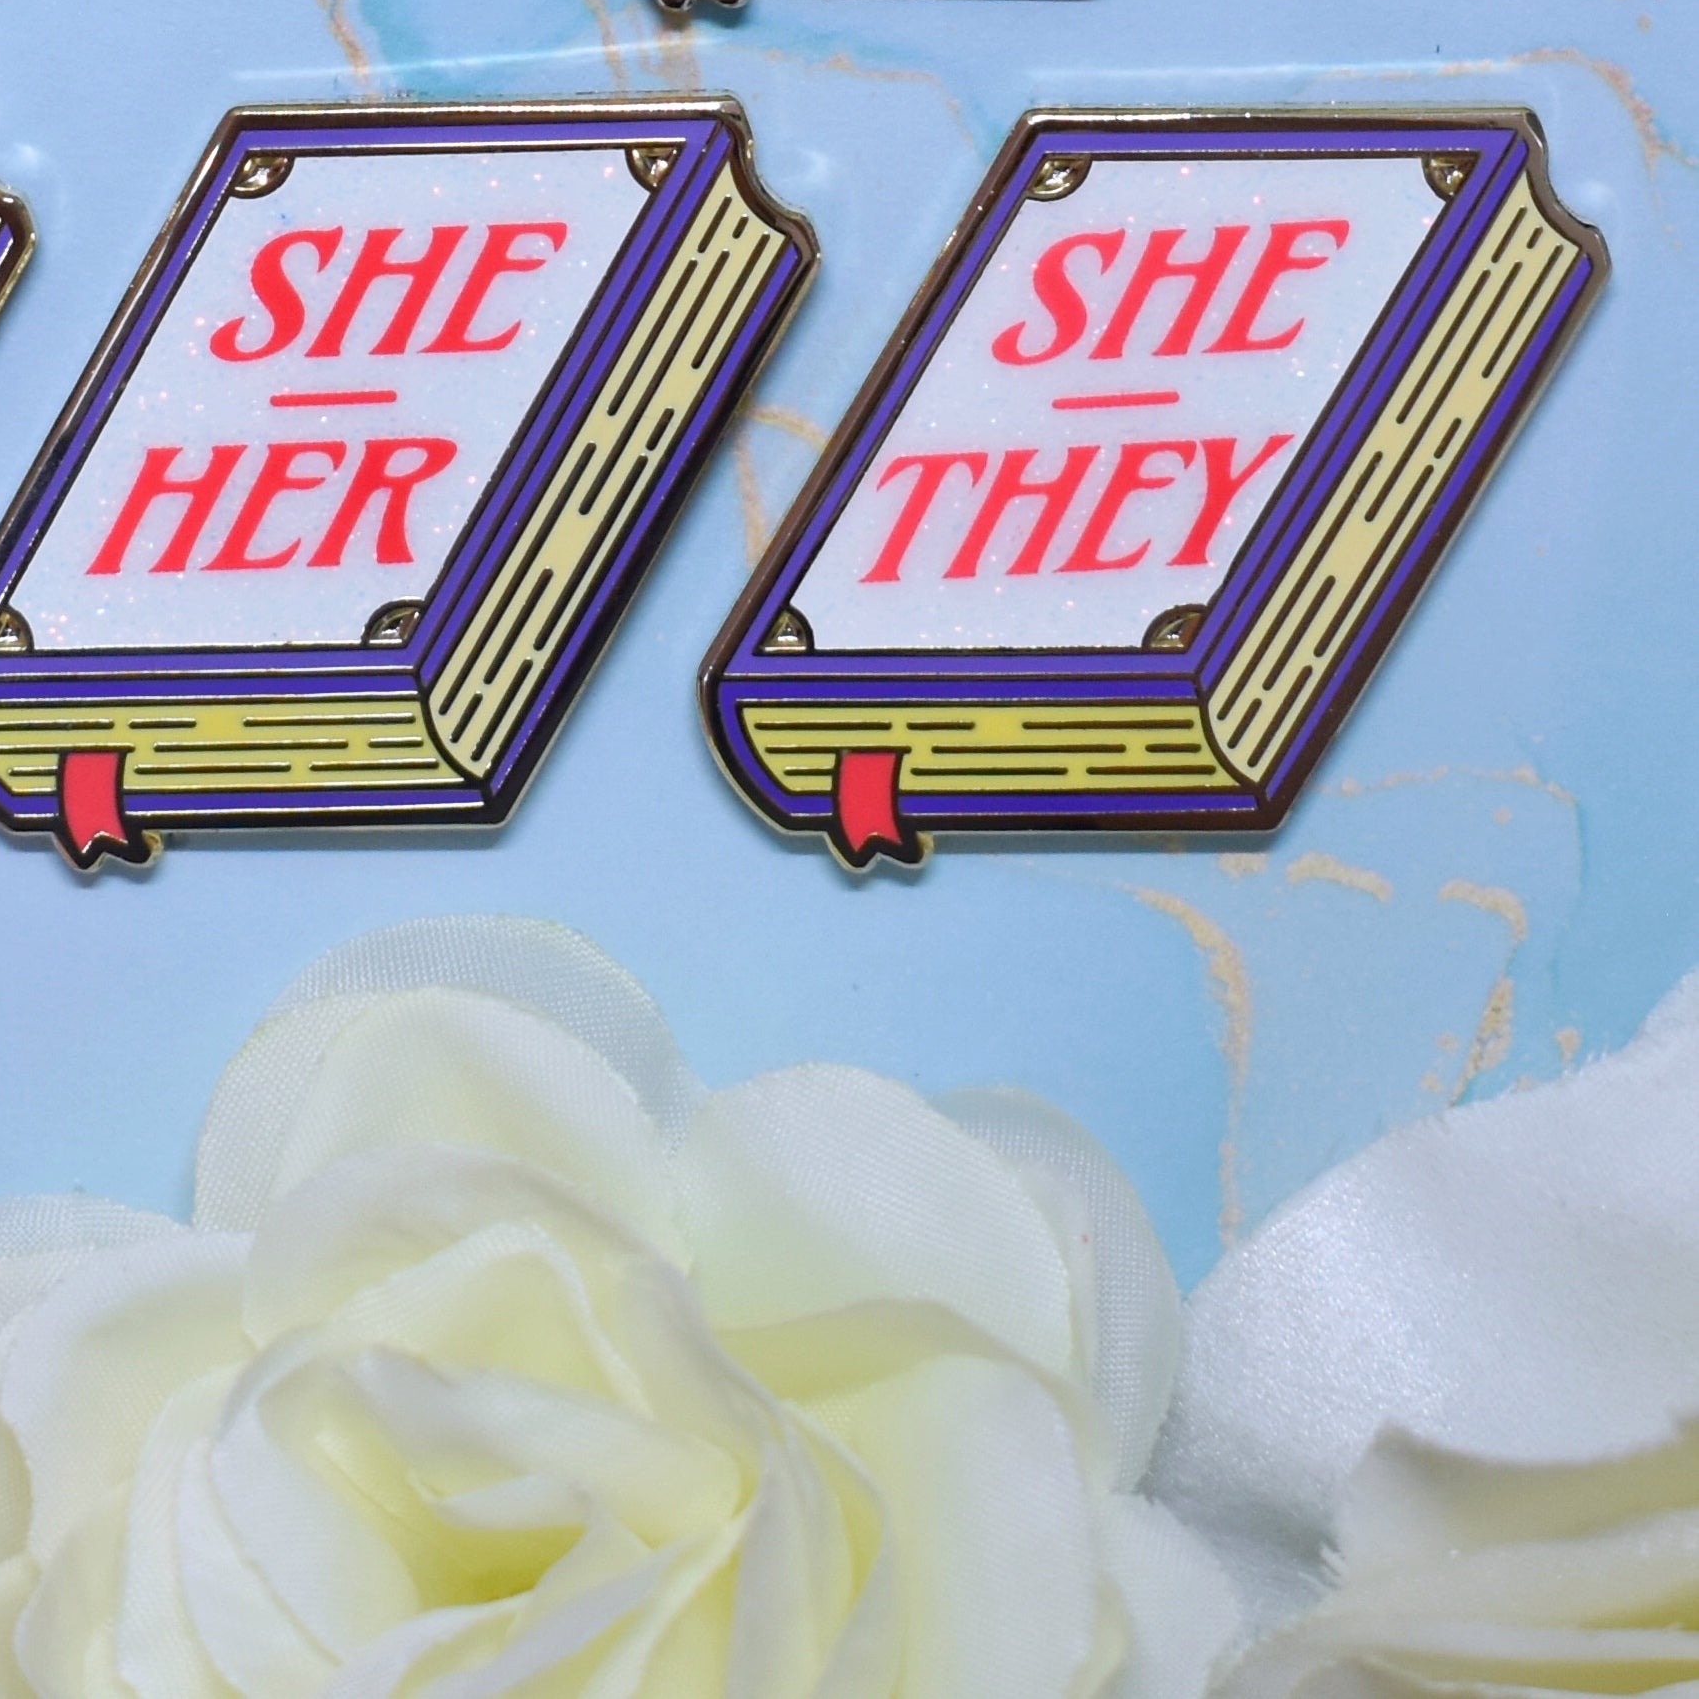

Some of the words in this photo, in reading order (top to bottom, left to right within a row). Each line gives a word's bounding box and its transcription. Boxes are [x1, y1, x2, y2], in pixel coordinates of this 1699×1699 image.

[208, 220, 569, 364] SHE
[990, 218, 1352, 368] SHE
[86, 436, 460, 577] HER
[861, 432, 1295, 584] THEY
